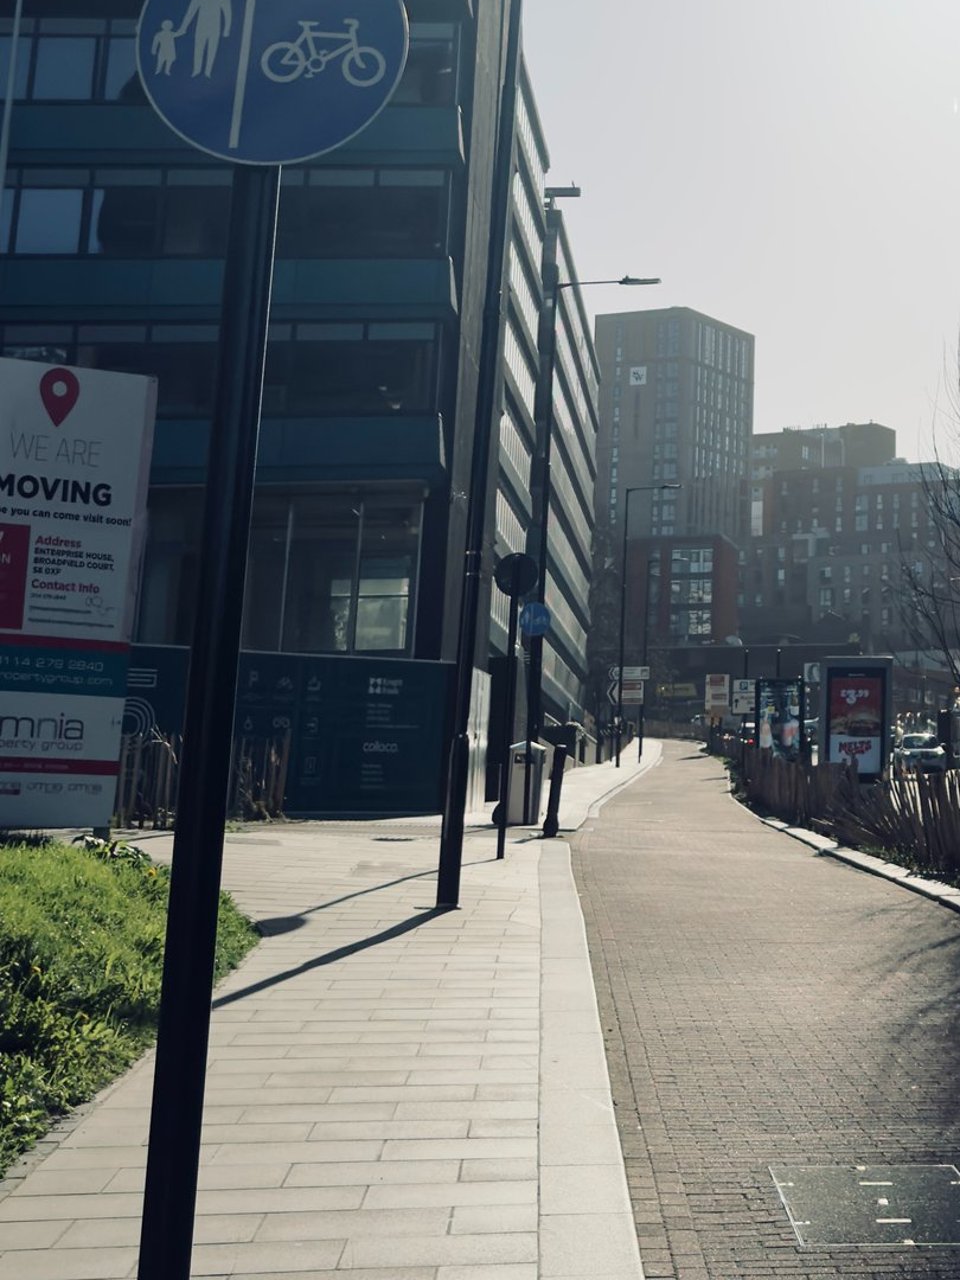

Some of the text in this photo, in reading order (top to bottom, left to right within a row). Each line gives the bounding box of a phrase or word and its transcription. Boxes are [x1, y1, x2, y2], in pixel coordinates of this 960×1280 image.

[10, 431, 103, 468] WE ARE
[0, 473, 112, 507] MOVING
[11, 508, 30, 517] you
[32, 509, 51, 518] can
[53, 511, 80, 521] come
[83, 513, 103, 525] visit
[106, 517, 132, 527] soon!
[35, 535, 82, 549] Address
[33, 556, 85, 568] BROADFIELD
[34, 547, 115, 563] ENTERPRISE HOUSE,
[32, 579, 100, 594] Contact Info
[41, 740, 84, 752] group
